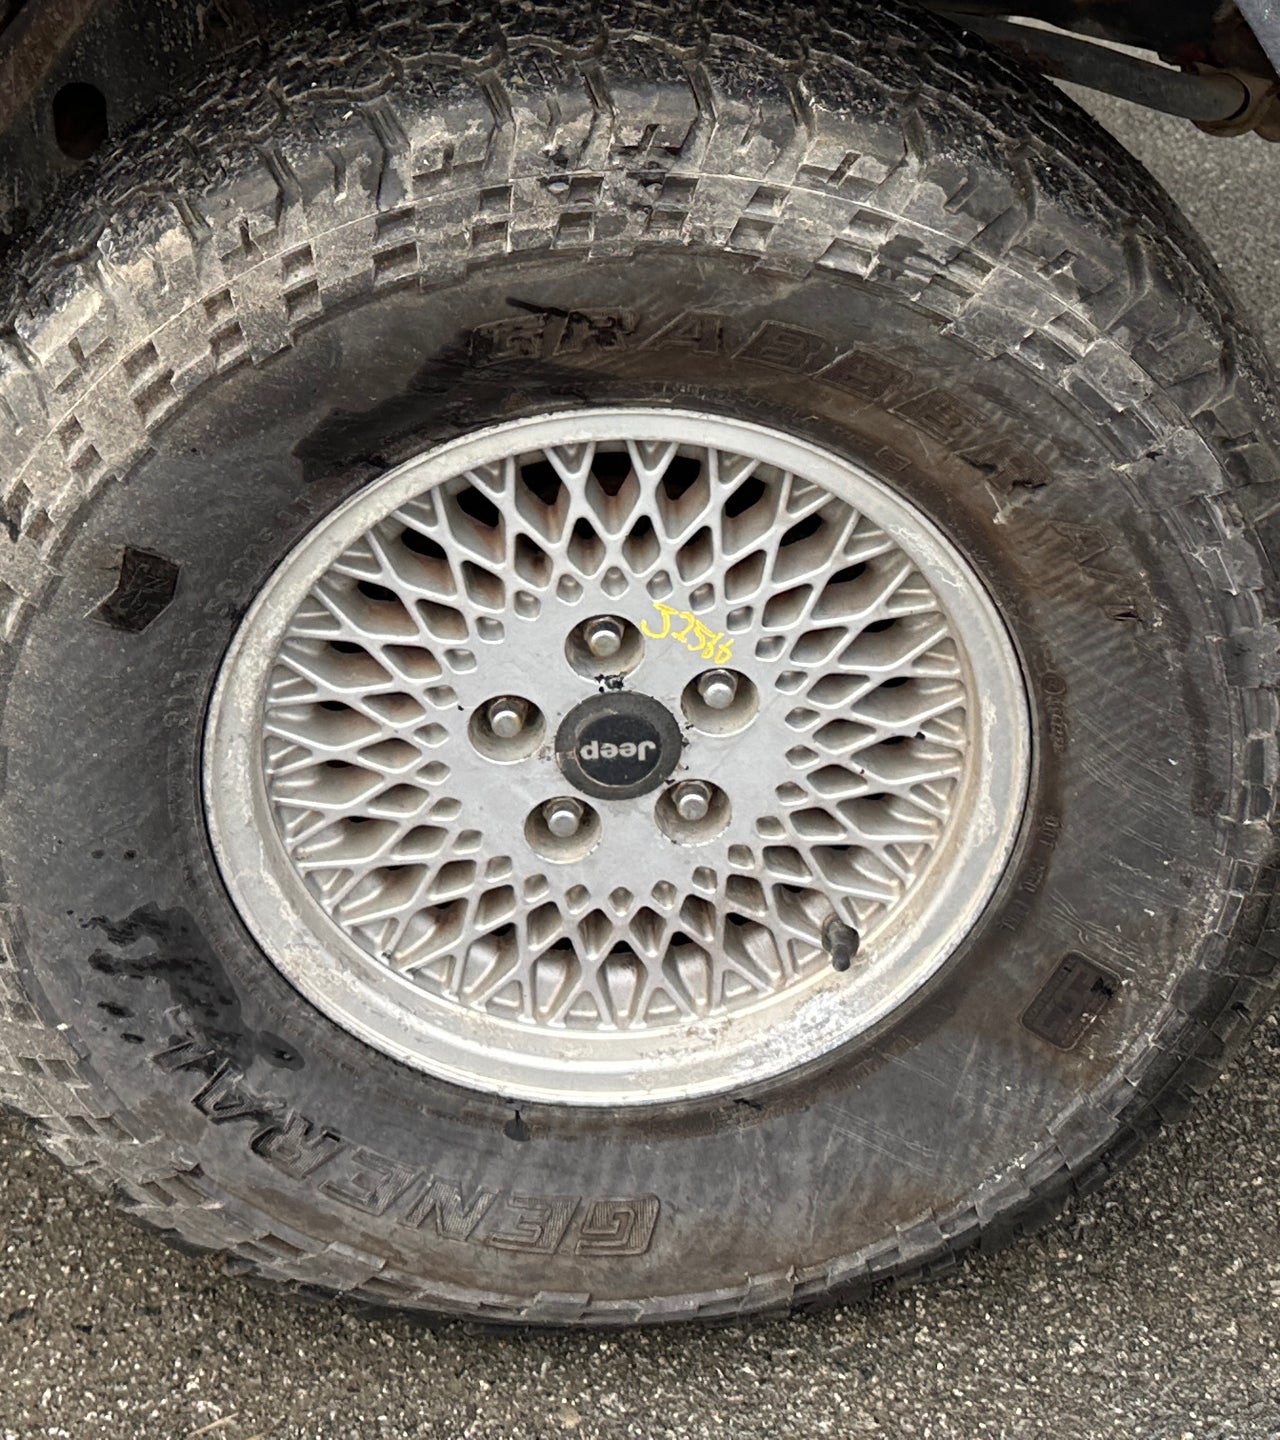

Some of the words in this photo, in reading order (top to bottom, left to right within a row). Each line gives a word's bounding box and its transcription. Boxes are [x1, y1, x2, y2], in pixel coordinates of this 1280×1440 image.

[640, 600, 735, 664] J2566
[579, 739, 656, 761] Jeep
[148, 1004, 662, 1258] GENERAL
